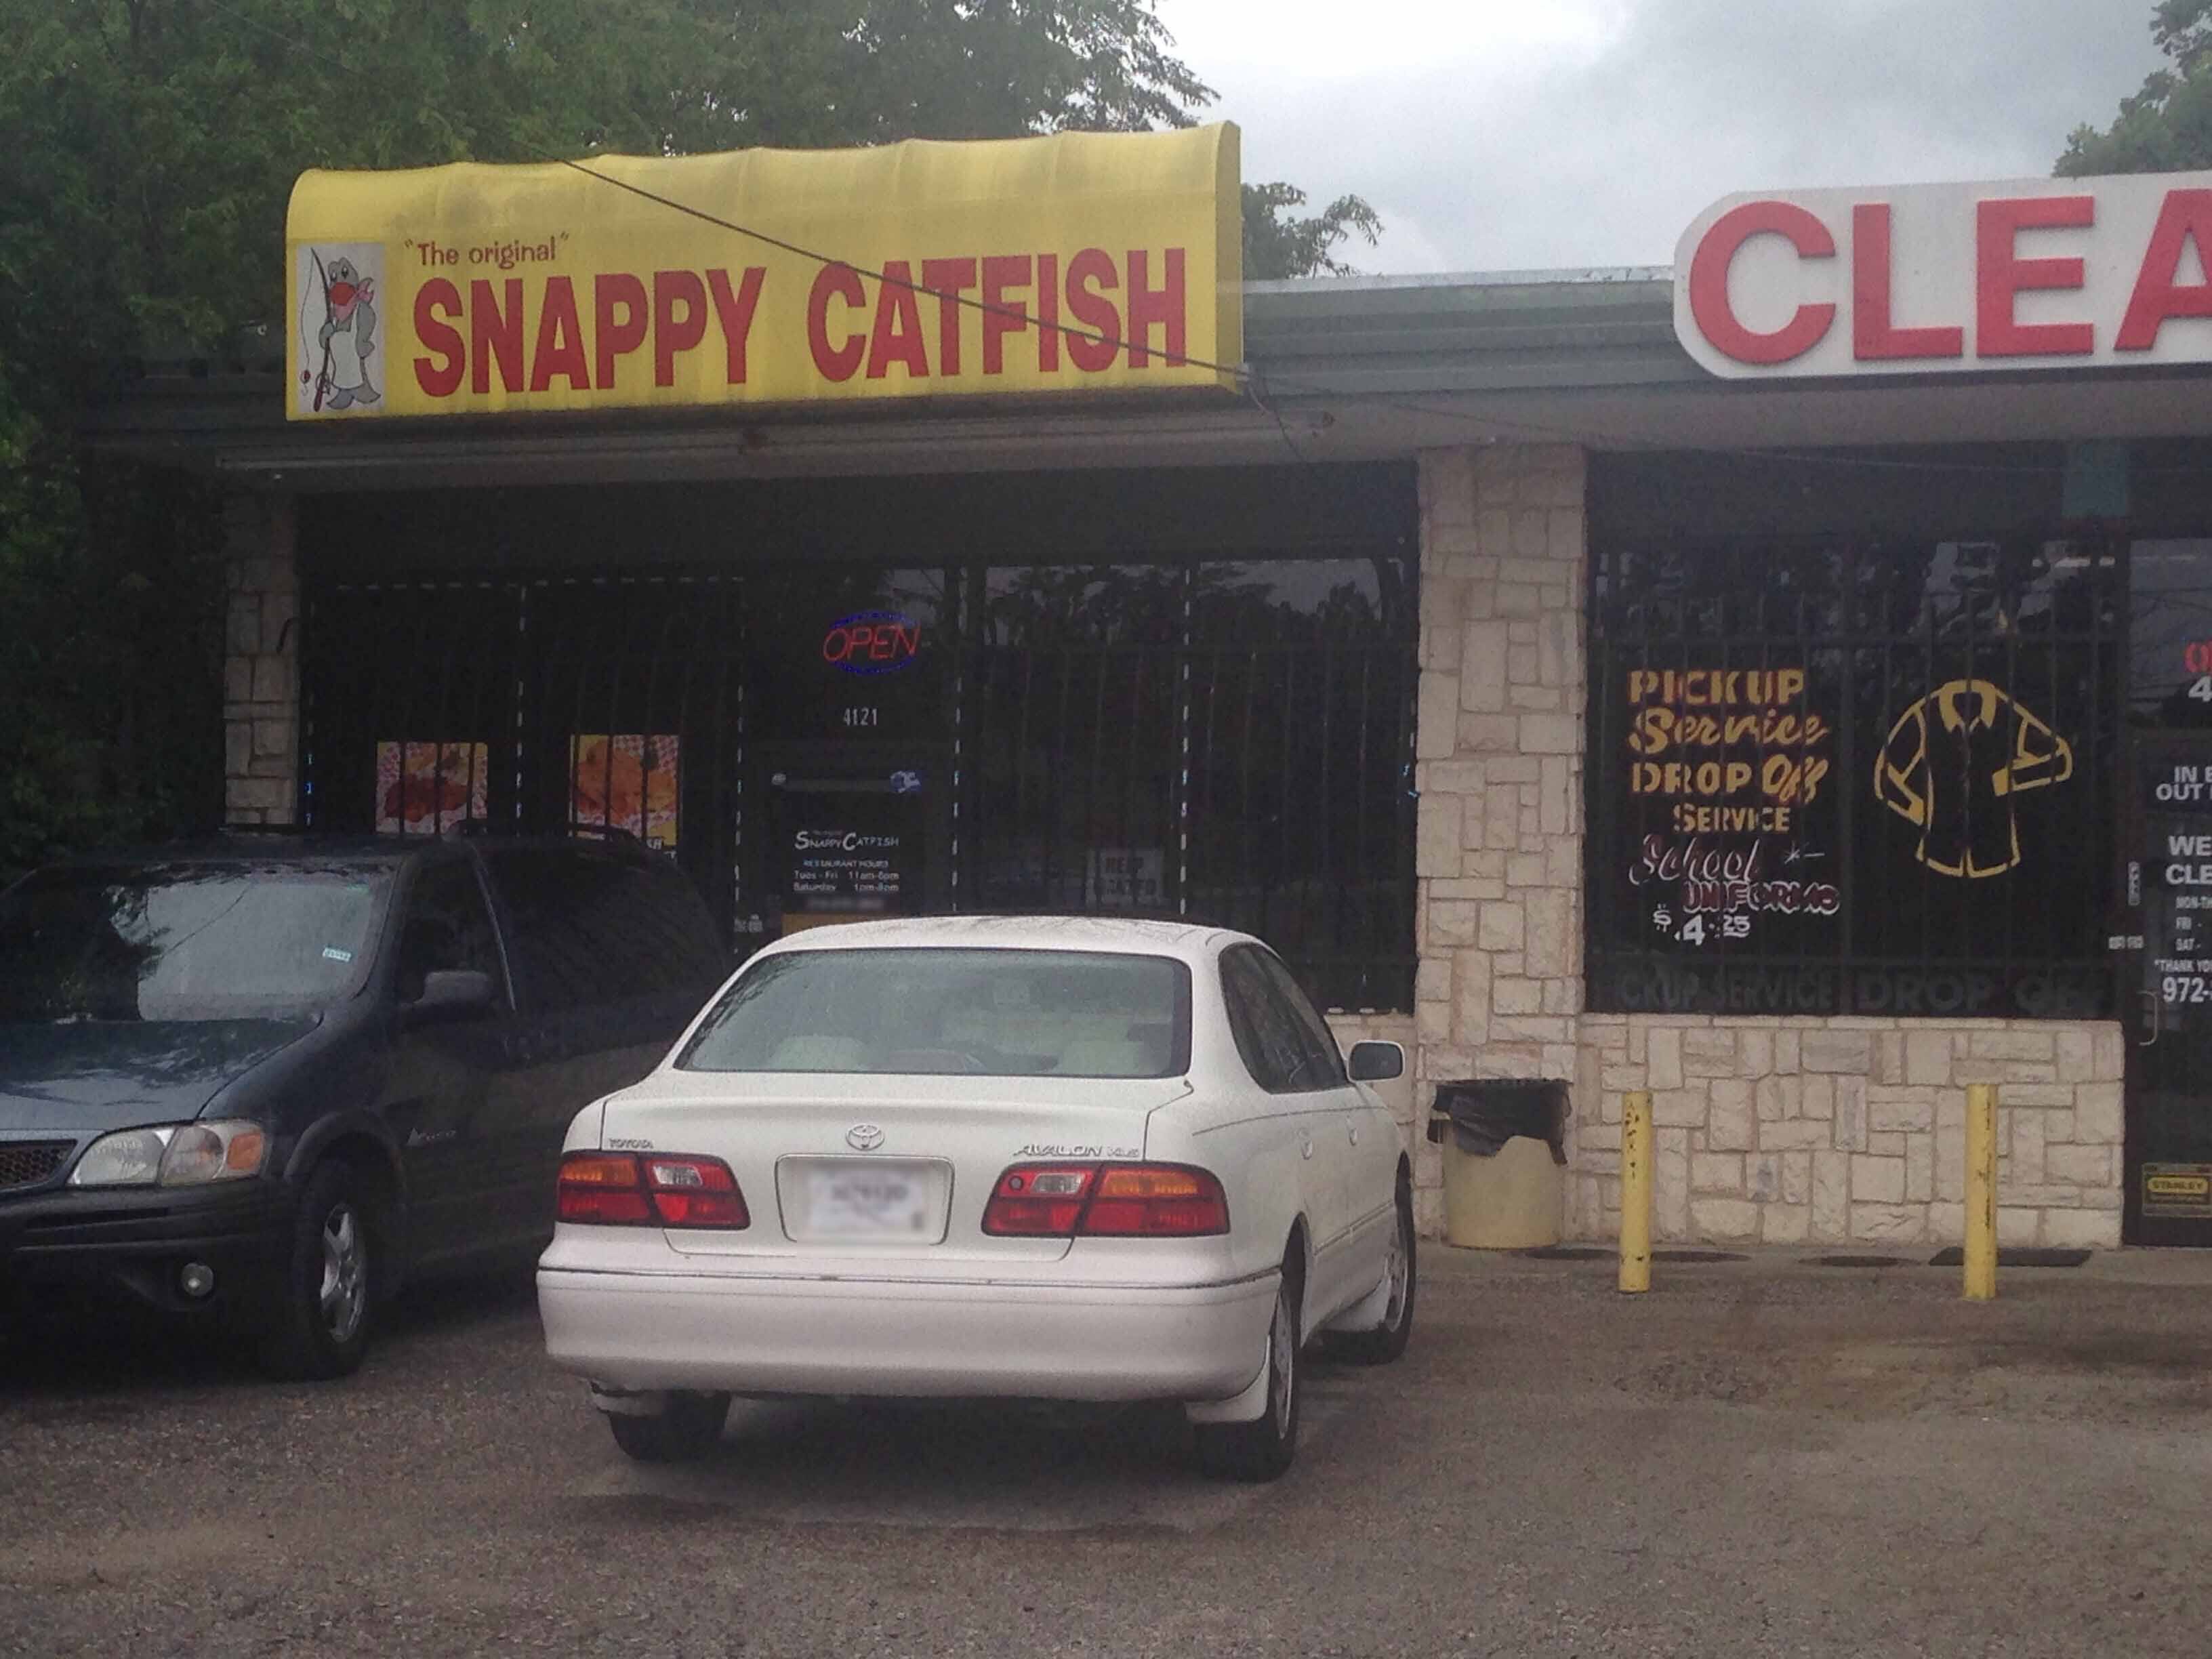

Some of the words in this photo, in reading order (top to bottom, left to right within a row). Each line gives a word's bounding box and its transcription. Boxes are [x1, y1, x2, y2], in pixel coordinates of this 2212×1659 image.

[412, 266, 768, 398] SNAPPY
[806, 247, 1189, 384] CATFISH
[823, 623, 920, 662] OPEN
[1630, 669, 1804, 705] PICKUP
[844, 707, 878, 727] 4121
[1629, 707, 1829, 754] Service
[1632, 762, 1753, 794] DROP
[2174, 766, 2197, 783] IN
[2156, 783, 2204, 800] OUT
[1674, 804, 1790, 832] SERVICE
[1629, 834, 1760, 884] School
[2175, 938, 2195, 951] SAT
[1857, 973, 1992, 1011] DROP
[1013, 1145, 1103, 1158] AVALON
